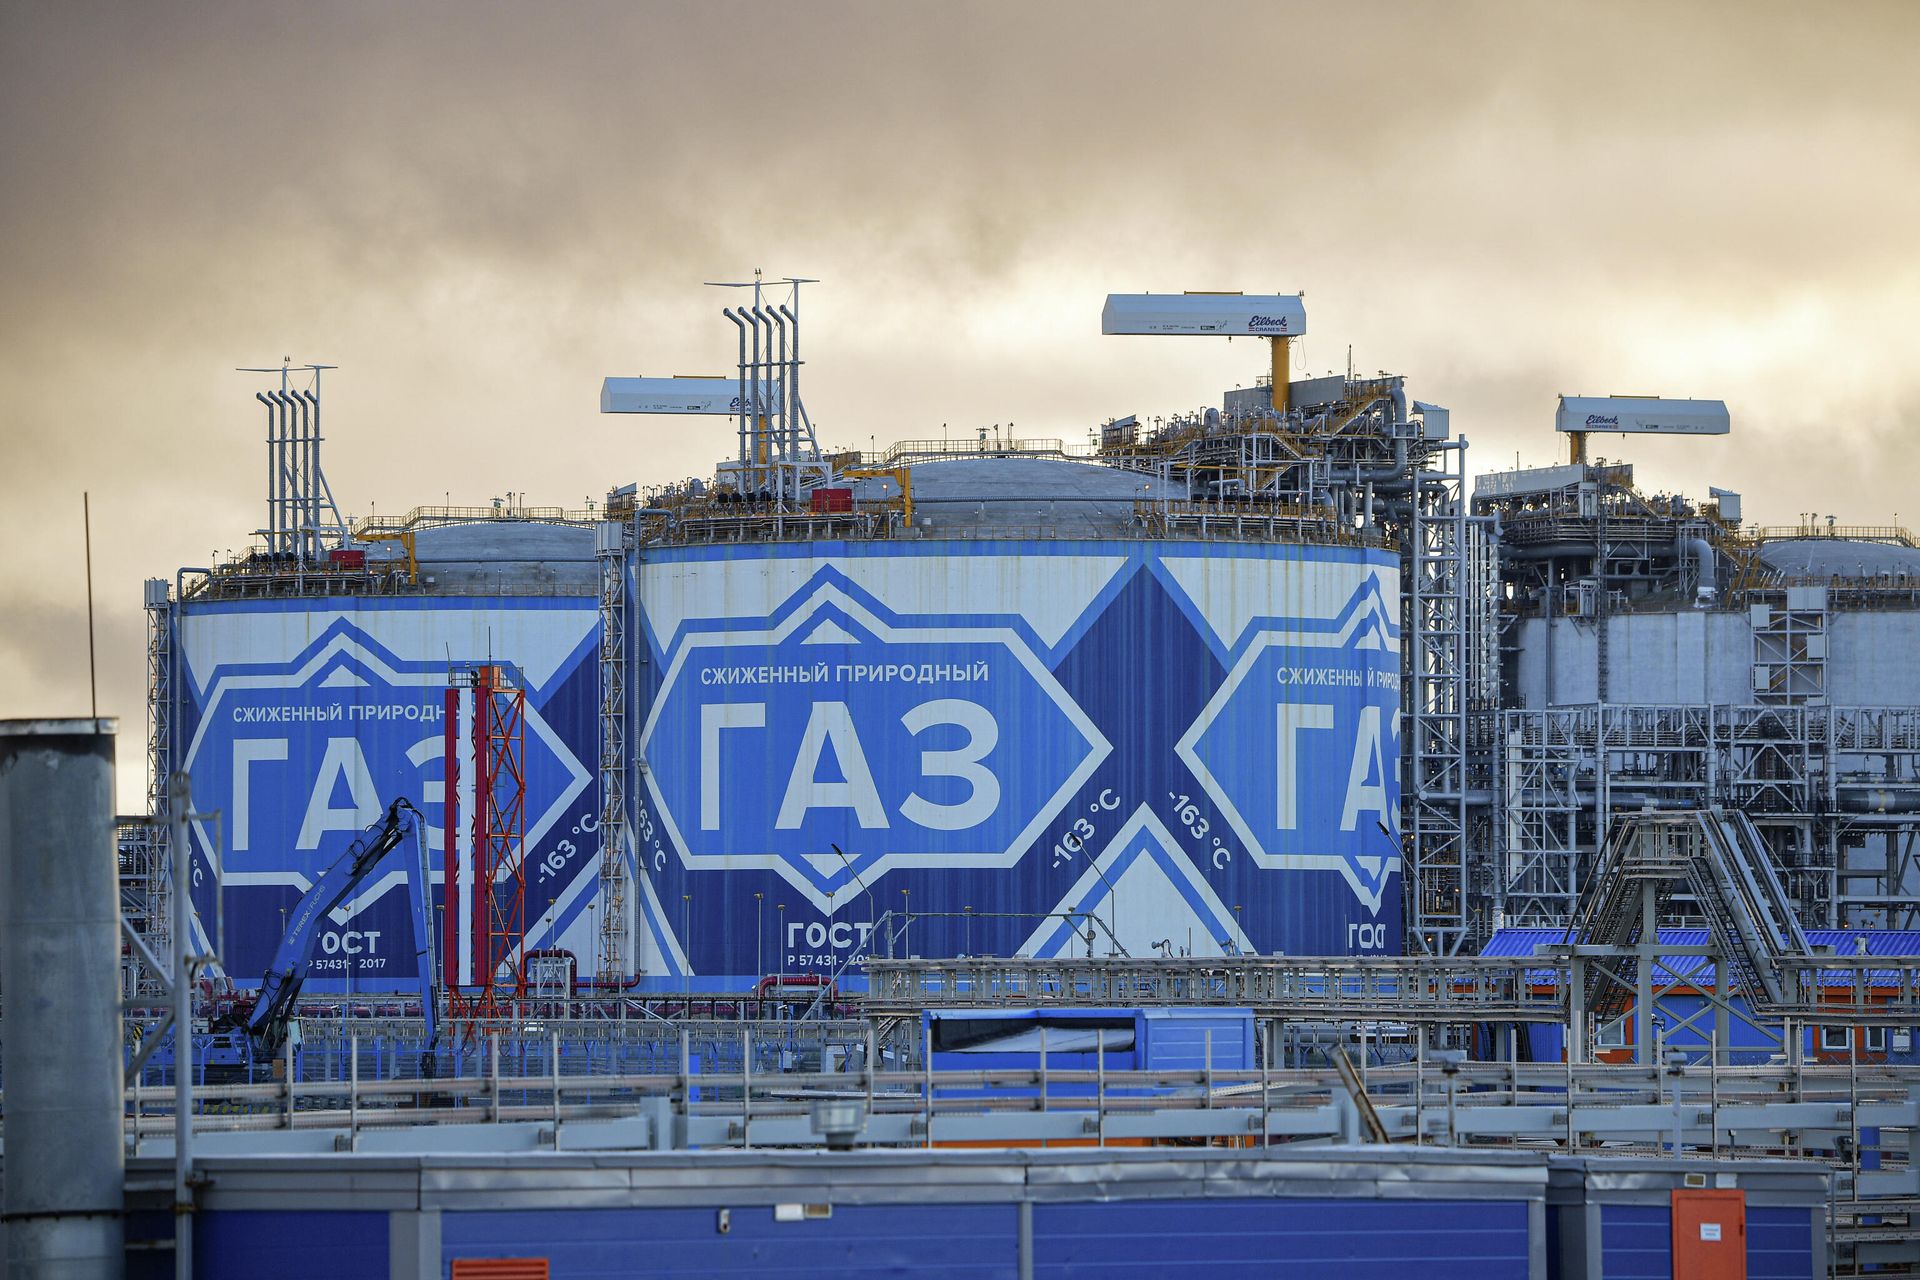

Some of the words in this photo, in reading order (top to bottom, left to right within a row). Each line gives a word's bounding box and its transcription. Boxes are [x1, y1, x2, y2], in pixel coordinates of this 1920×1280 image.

[1248, 315, 1288, 327] Eilbeck
[1586, 414, 1619, 424] Eilbeck
[701, 661, 829, 685] СЖИЖЕННЫЙ
[836, 660, 989, 684] ПРИРОДНЫЙ
[233, 702, 344, 723] СЖИЖЕННЫЙ
[700, 698, 1001, 831] ГАЗ
[1277, 703, 1401, 832] ГА
[1052, 818, 1096, 869] -163
[1090, 788, 1121, 813] °C
[1168, 791, 1210, 839] -163
[1213, 837, 1231, 870] °C
[538, 839, 577, 884] -163
[572, 813, 599, 835] °C
[655, 839, 666, 872] °C
[293, 910, 311, 936] TEREX
[787, 922, 873, 948] ГОСТ
[317, 931, 381, 955] ОСТ
[787, 955, 796, 966] Р
